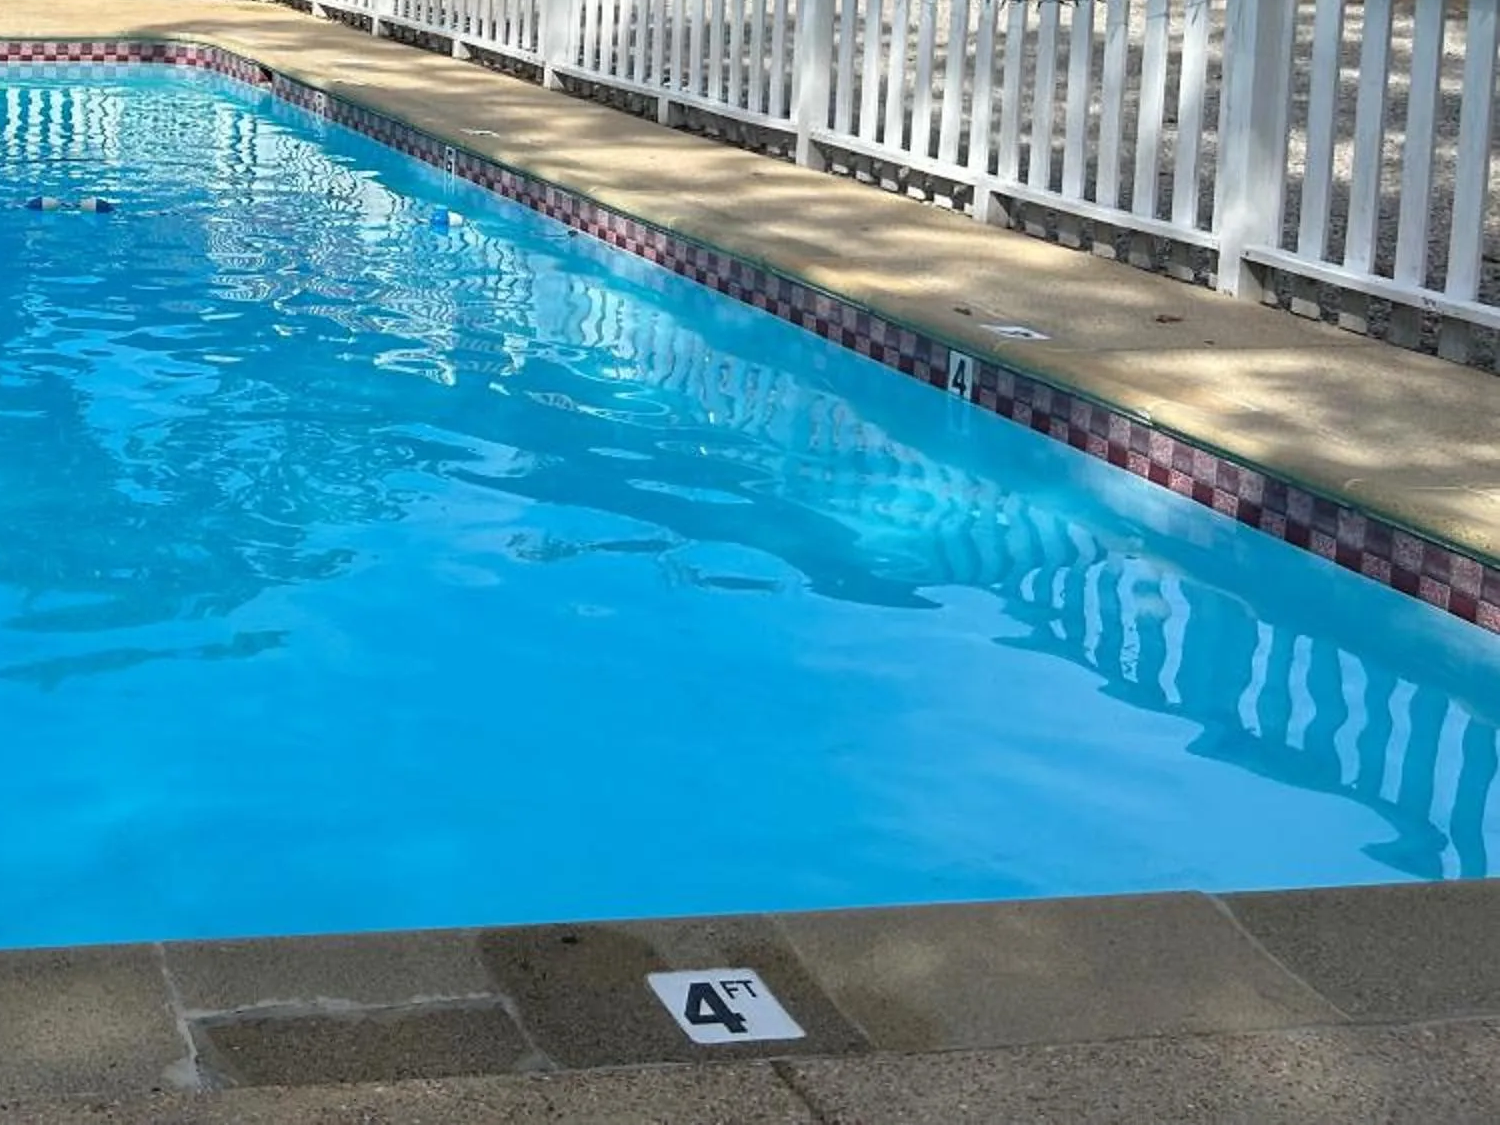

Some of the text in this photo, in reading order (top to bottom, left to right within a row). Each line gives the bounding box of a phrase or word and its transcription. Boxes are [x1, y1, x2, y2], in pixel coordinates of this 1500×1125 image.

[952, 360, 966, 396] 4
[684, 980, 758, 1034] 4 FT
